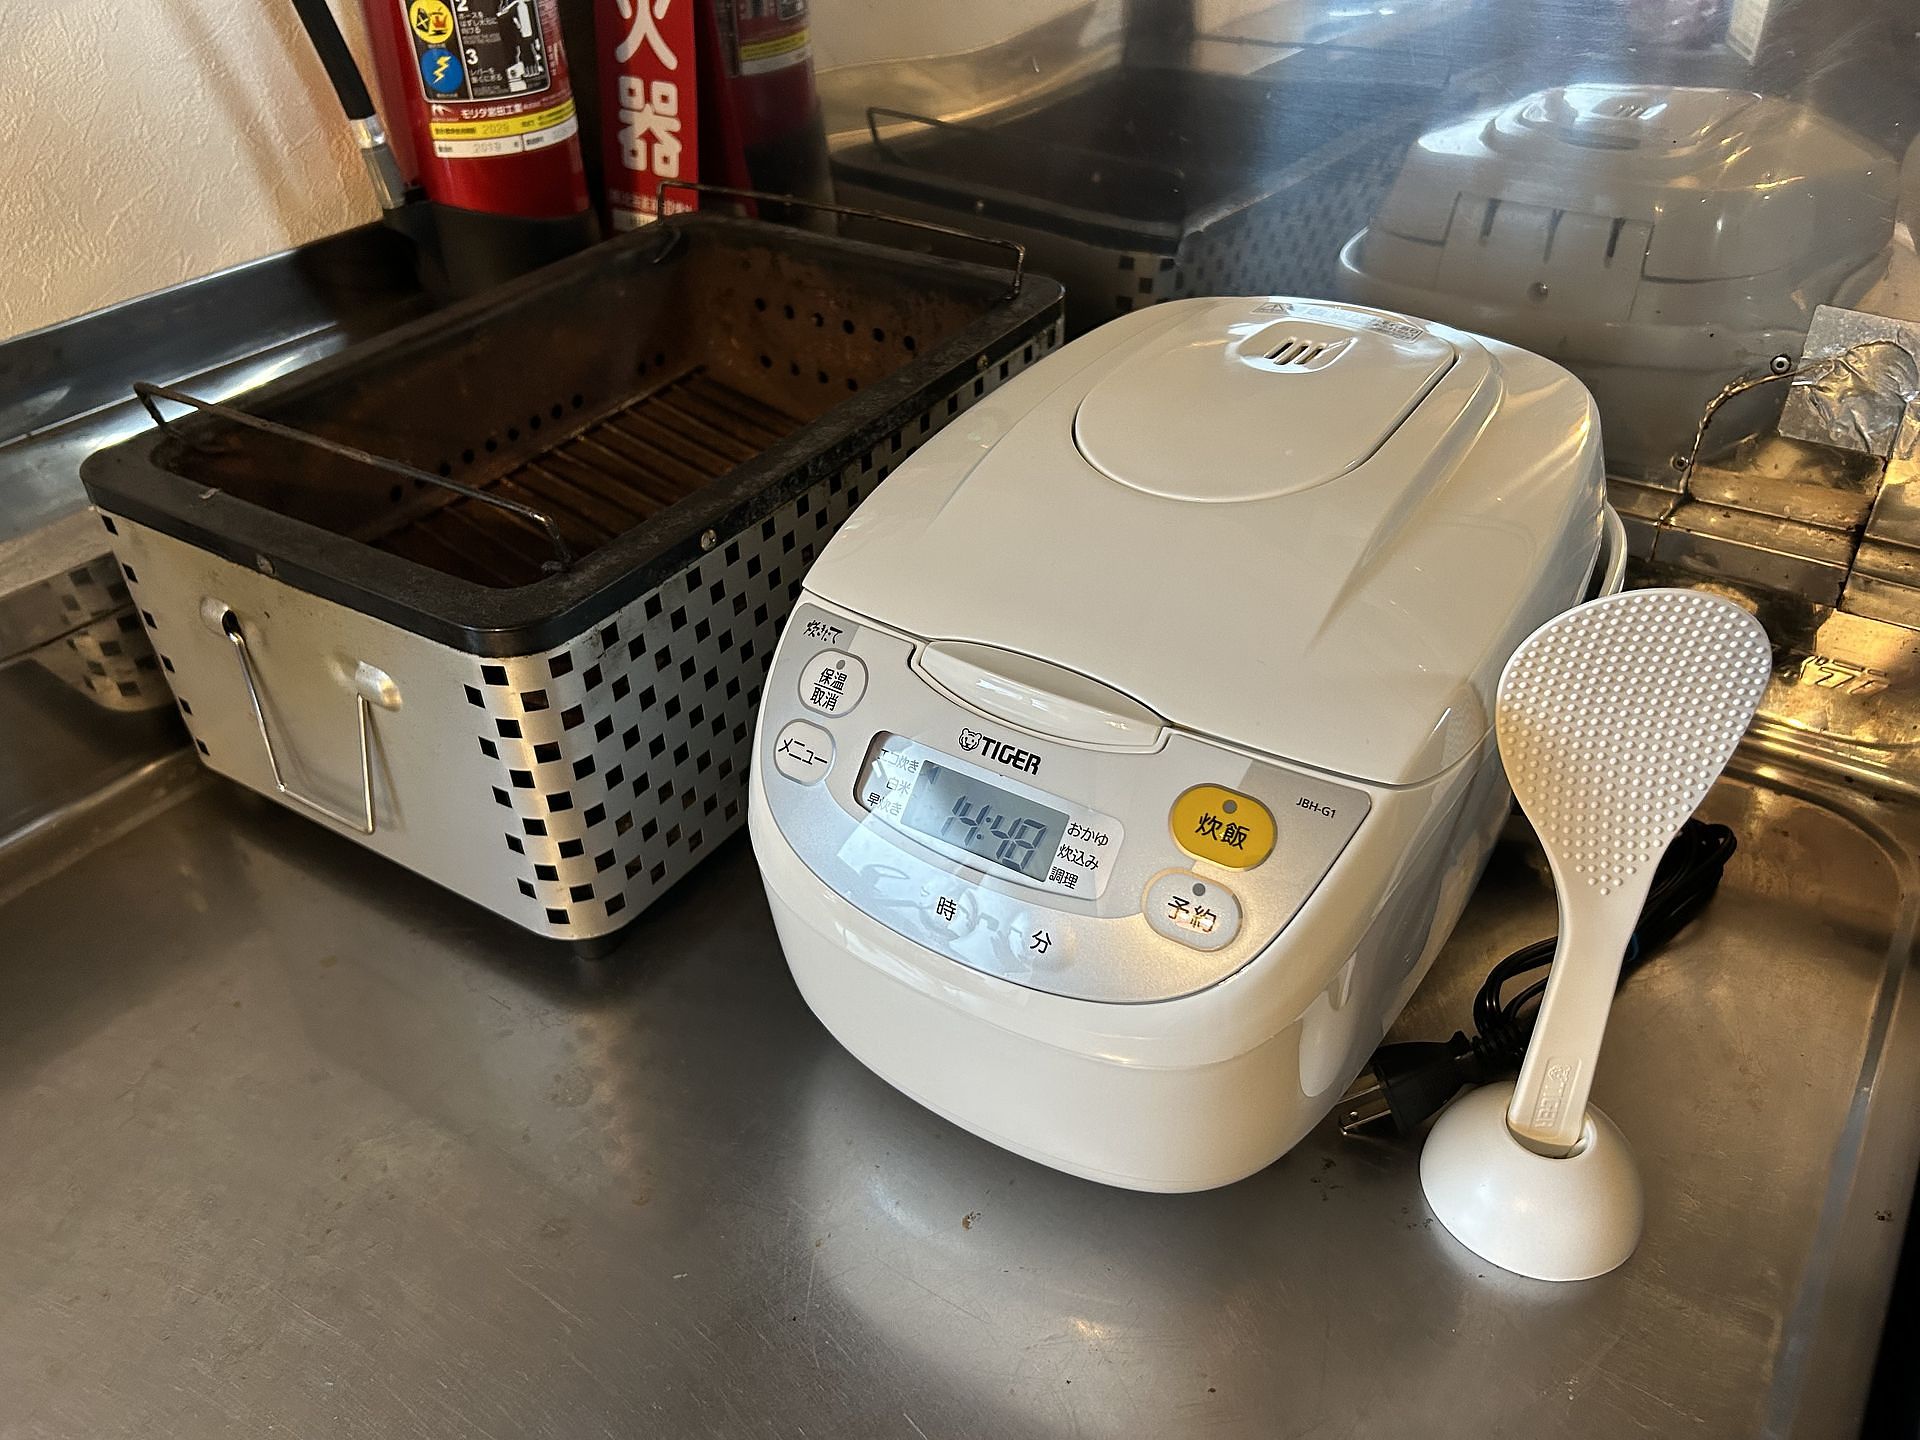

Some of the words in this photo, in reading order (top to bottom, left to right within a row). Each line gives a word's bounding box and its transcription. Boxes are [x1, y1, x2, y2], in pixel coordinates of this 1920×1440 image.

[465, 48, 479, 65] 3
[819, 668, 847, 690] 保温
[810, 686, 837, 711] 取消
[777, 737, 828, 766] メニュー
[876, 748, 920, 774] エコ炊き
[981, 736, 1041, 775] TIGER
[886, 777, 911, 794] 白米
[867, 792, 902, 815] 早炊き
[1296, 796, 1337, 820] JBH-G1
[941, 795, 1047, 871] 14:48
[1067, 821, 1109, 847] おかゆ
[1195, 812, 1250, 850] 炊飯
[1057, 844, 1099, 871] 炊込み
[1049, 866, 1079, 889] 調理
[936, 896, 957, 921] 時
[1167, 895, 1217, 933] 予約
[1030, 930, 1052, 954] 分
